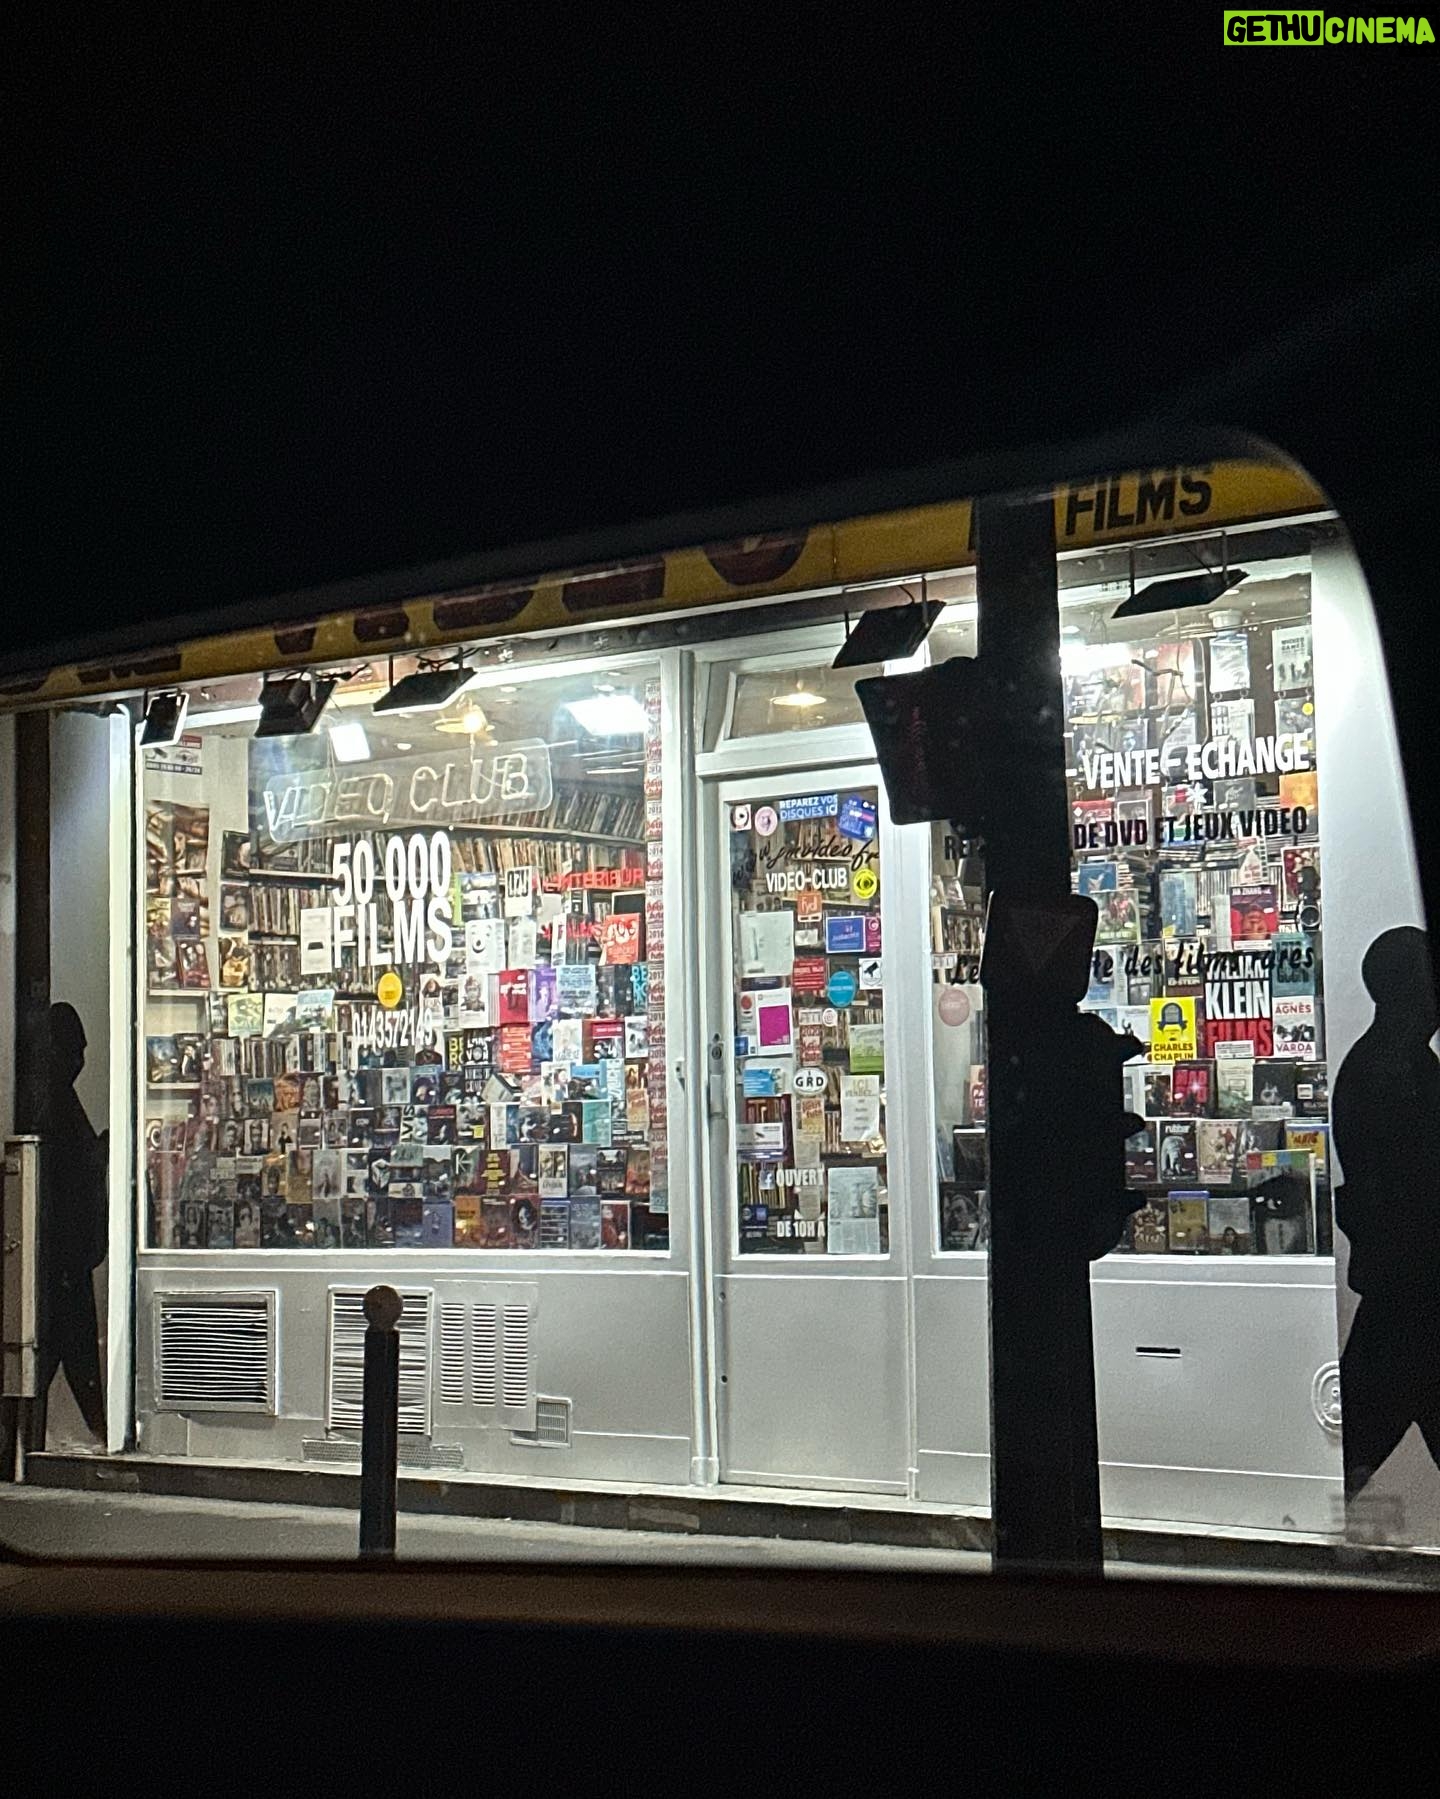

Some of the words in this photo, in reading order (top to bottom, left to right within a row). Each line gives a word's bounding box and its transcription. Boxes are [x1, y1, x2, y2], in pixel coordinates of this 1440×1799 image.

[1065, 472, 1212, 535] FILMS
[1082, 748, 1160, 790] VENTE
[263, 772, 394, 832] VIDEO
[409, 752, 530, 813] CLUB
[780, 807, 823, 820] DISQUES
[1074, 823, 1099, 849] DE
[1105, 818, 1148, 847] DVD
[1157, 816, 1177, 843] ET
[1183, 810, 1235, 841] JEUX
[1242, 805, 1307, 837] VIDEO
[332, 840, 375, 906] 50
[385, 831, 452, 902] 000
[507, 868, 529, 898] OZU
[766, 867, 847, 893] VIDEO-CLUB
[333, 897, 452, 969] FILMS
[1124, 943, 1163, 977] des
[1205, 980, 1269, 1020] KLEIN
[1154, 1042, 1193, 1051] CHARLES
[1206, 1019, 1273, 1057] FILMS
[1276, 1043, 1313, 1052] VARDA
[1154, 1052, 1194, 1061] CHAPLIN
[776, 1168, 825, 1186] OUVERT
[776, 1222, 791, 1238] DE
[793, 1220, 815, 1237] 10H
